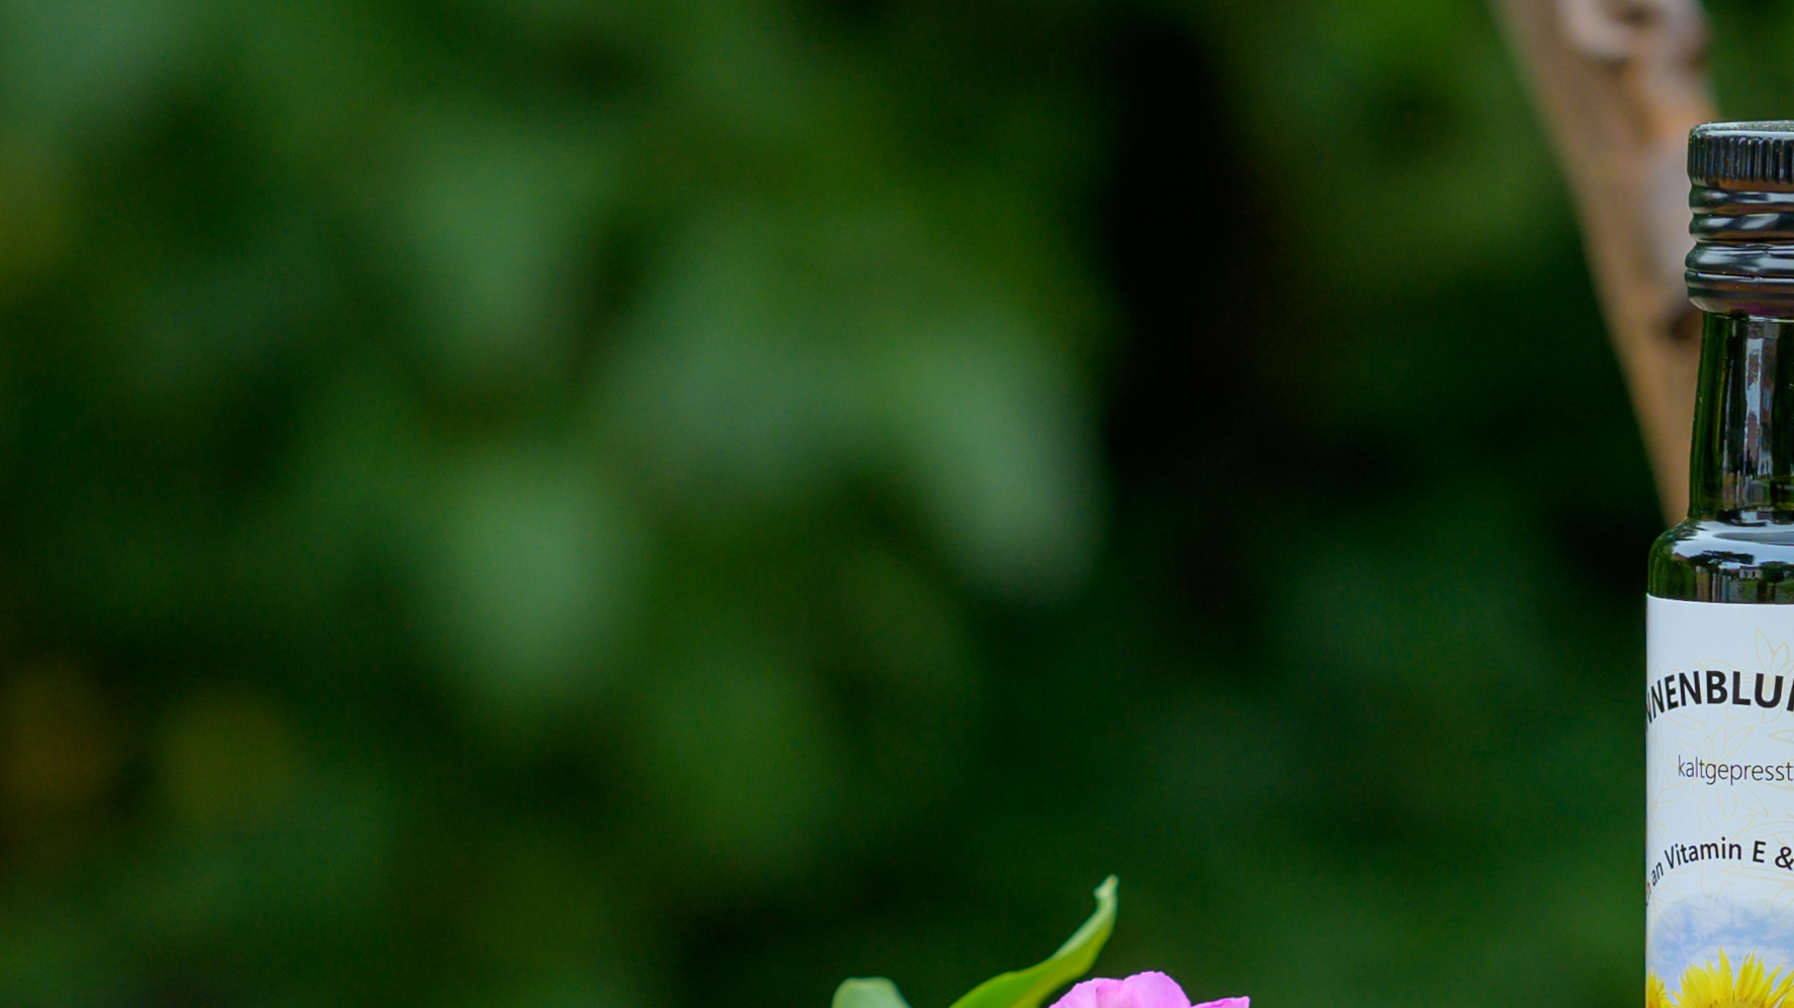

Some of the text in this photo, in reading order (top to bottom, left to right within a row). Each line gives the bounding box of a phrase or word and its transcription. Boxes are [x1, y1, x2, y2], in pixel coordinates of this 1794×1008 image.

[1677, 754, 1794, 786] kaltgepresst
[1651, 861, 1664, 887] an
[1664, 836, 1742, 870] Vitamin
[1752, 840, 1766, 863] E
[1775, 846, 1794, 870] &
